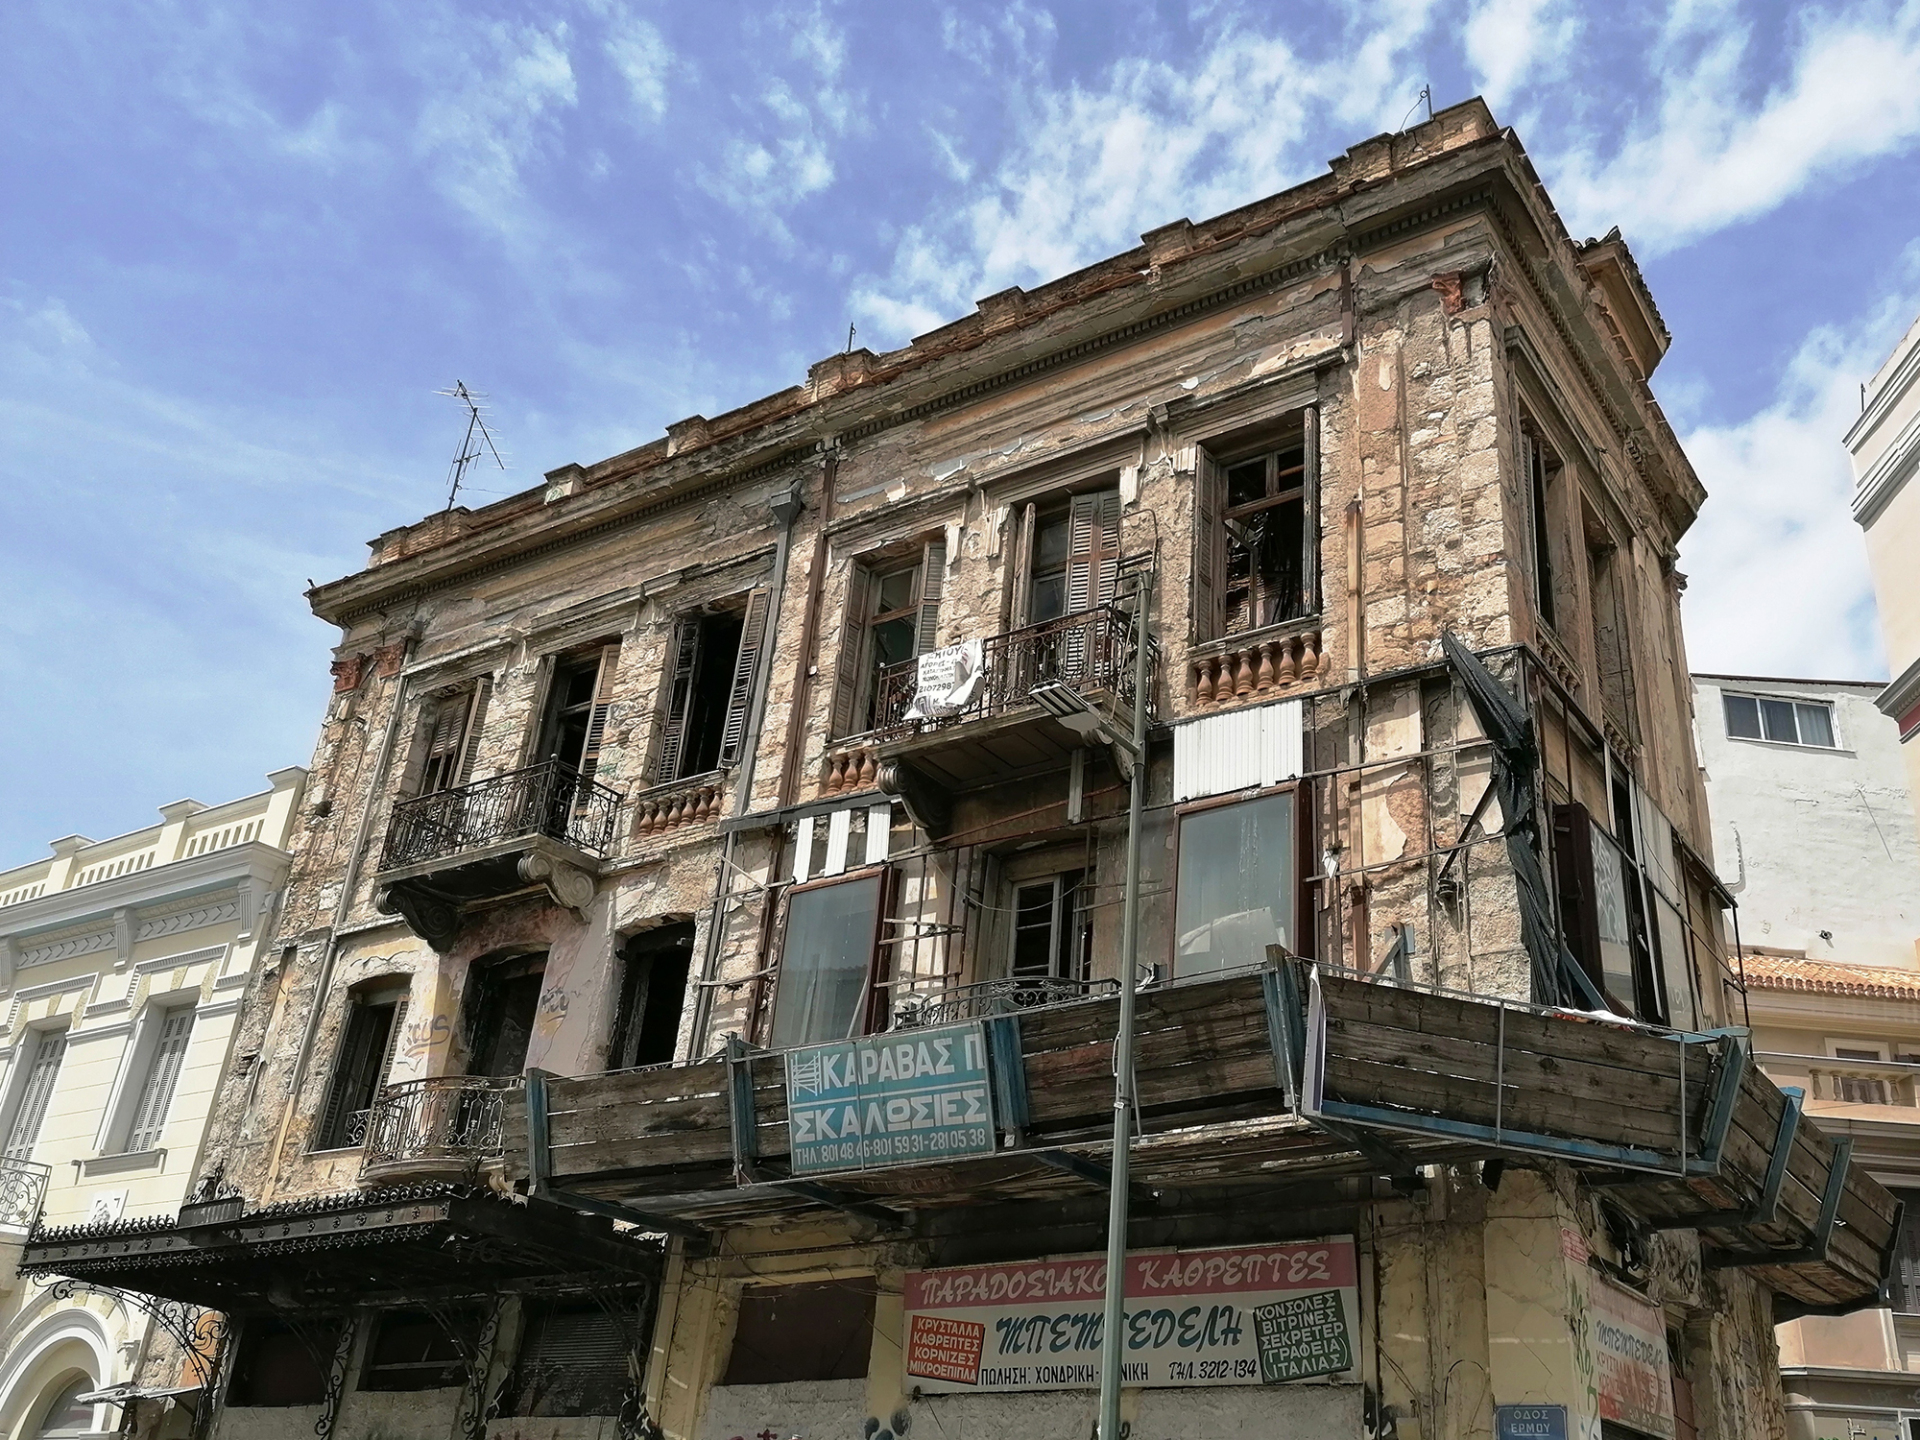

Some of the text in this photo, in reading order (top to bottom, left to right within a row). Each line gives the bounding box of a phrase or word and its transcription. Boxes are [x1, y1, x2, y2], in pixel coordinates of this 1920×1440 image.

[823, 1037, 955, 1090] ΚΑΡΑΒΑΣ
[793, 1088, 986, 1143] ΣΚΑΛΩΣΙΕΣ
[1138, 1251, 1331, 1290] ΚΑΘΡΕΠΤΕΣ
[1256, 1293, 1336, 1321] ΚΟΝΣΟΛΕΣ
[917, 1317, 980, 1338] ΚΡΥΣΤΑΛΛΑ
[996, 1305, 1242, 1355] ΜΠΕΜΕΔΕΛΗ
[1262, 1308, 1337, 1335] ΒΙΤΡΙΝΕΣ
[913, 1331, 980, 1351] ΚΑΘΡΕΠΤΕΣ
[1260, 1322, 1344, 1350] ΣΕΚΡΕΤΕΡ
[914, 1346, 976, 1366] ΚΟΡΝΙΖΕΣ
[909, 1359, 977, 1382] ΜΙΚΡΟΕΠΙΠΛΑ
[1511, 1423, 1551, 1434] ΕΡΜΟΥ
[1513, 1410, 1549, 1420] ΟΔΟΣ
